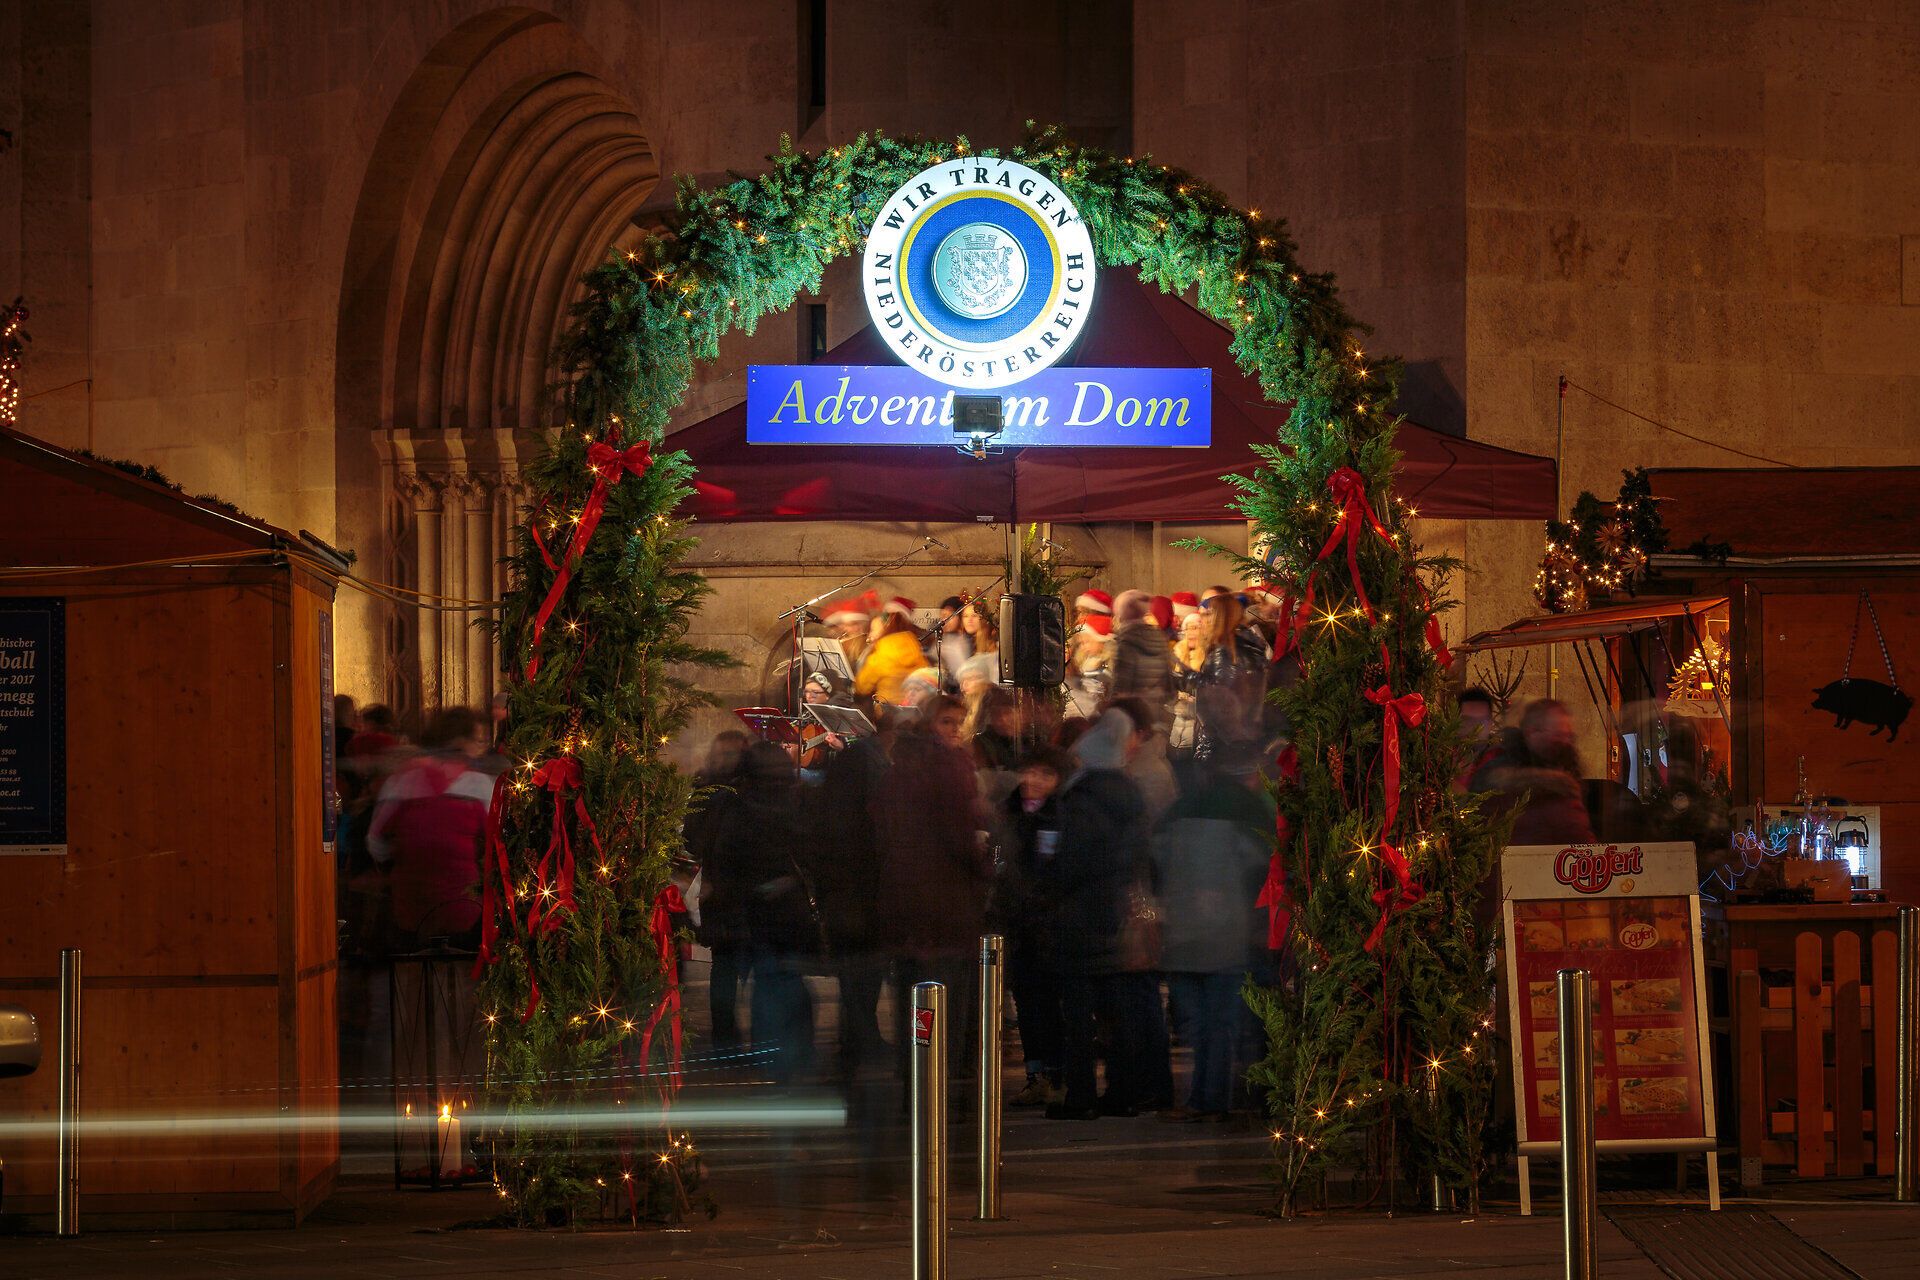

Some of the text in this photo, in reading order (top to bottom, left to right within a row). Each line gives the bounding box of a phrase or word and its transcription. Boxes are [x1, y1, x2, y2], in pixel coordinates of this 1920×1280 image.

[875, 166, 1085, 378] WIR TRAGEN NIEDERÖSTERREICH
[768, 376, 955, 427] Advent
[1064, 380, 1191, 427] Dom
[0, 650, 36, 670] ball
[10, 674, 36, 685] 2017
[1553, 845, 1644, 895] Göpfert
